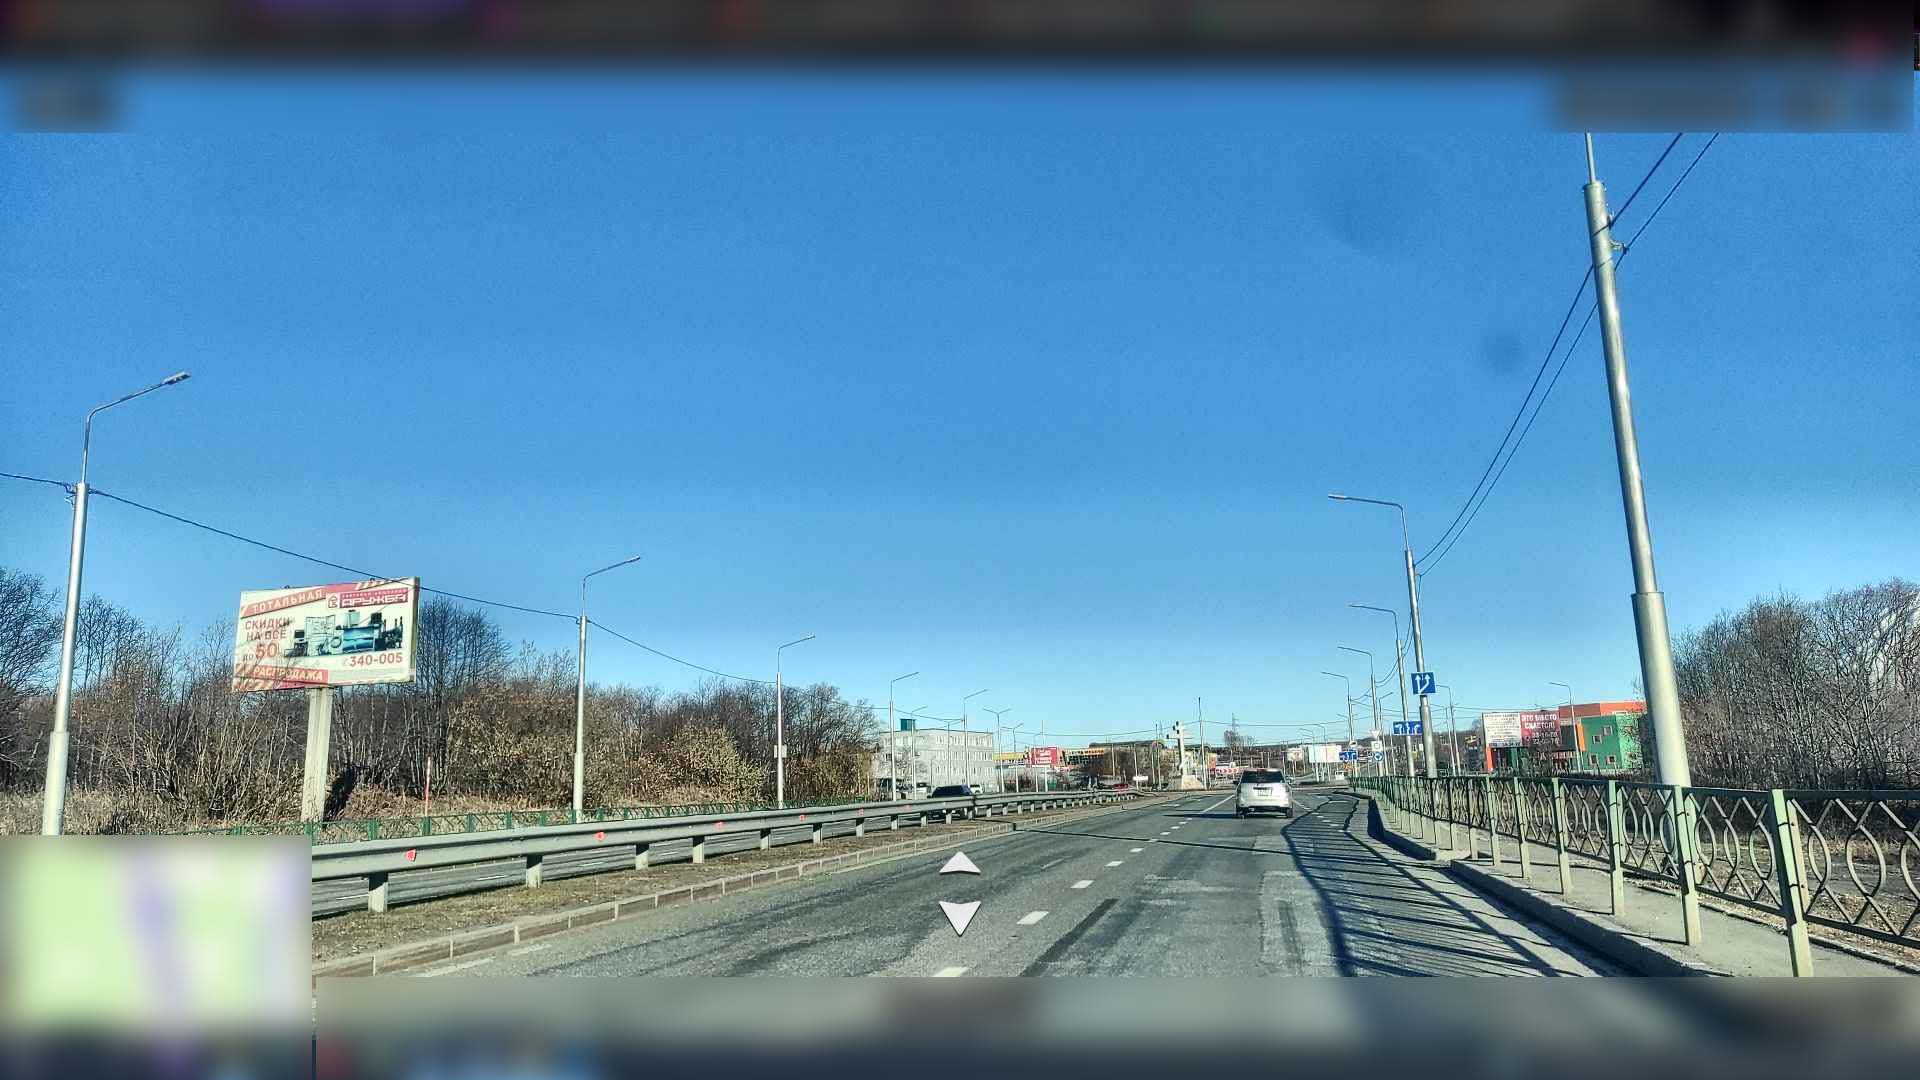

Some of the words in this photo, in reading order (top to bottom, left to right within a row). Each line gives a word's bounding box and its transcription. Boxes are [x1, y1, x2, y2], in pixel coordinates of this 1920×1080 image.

[252, 588, 323, 613] ТОТАЛЬНАЯ
[341, 593, 407, 607] ДРУЖБА
[245, 617, 290, 630] СКИДКИ
[246, 631, 261, 641] НА
[350, 652, 403, 667] 340-005
[253, 665, 323, 681] РАСПРОДАЖА
